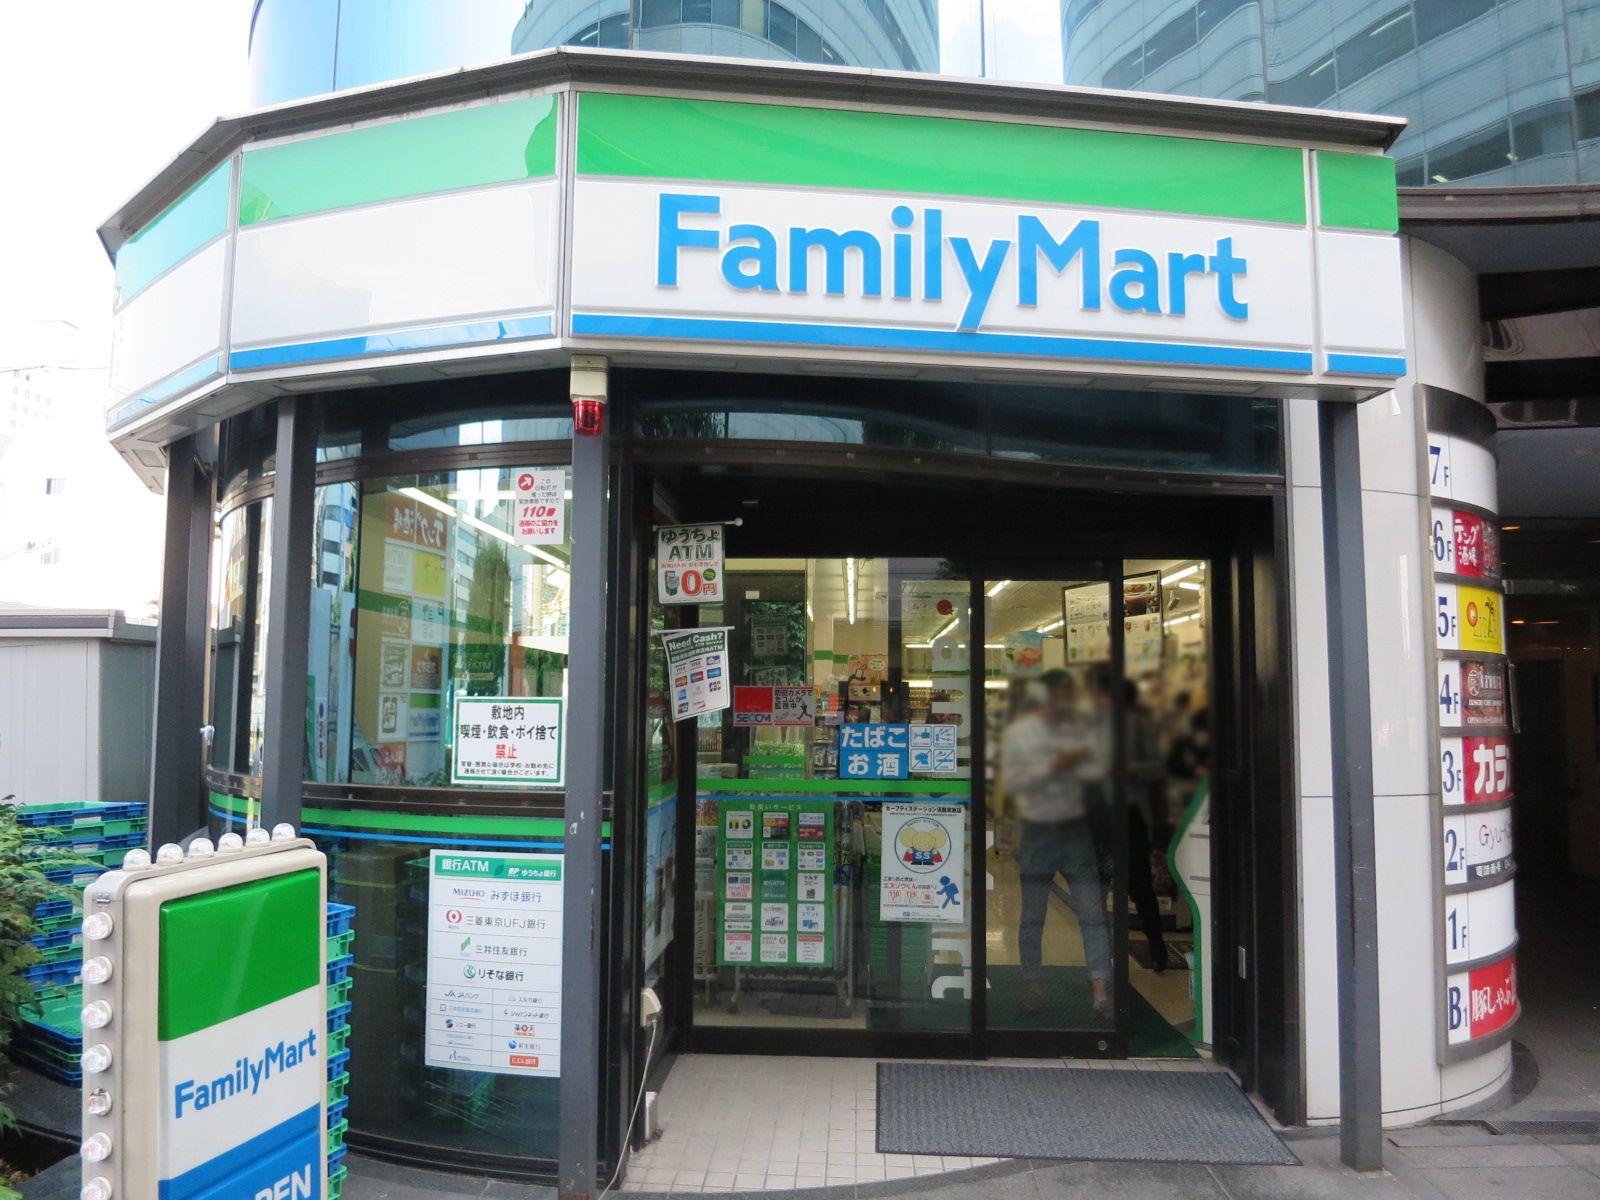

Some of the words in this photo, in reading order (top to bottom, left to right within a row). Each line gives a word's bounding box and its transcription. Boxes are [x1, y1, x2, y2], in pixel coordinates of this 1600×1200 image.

[655, 193, 1249, 332] FamilyMart
[1429, 446, 1449, 487] 7F
[661, 528, 719, 545] ゆうちょ
[1433, 520, 1453, 562] 6F
[669, 544, 713, 561] ATM
[1437, 596, 1457, 638] 5F
[668, 637, 692, 651] Need
[692, 632, 724, 644] Cash?
[775, 689, 813, 697] 防犯カメラで
[1440, 674, 1459, 715] 4F
[491, 704, 525, 720] 敷地内
[736, 713, 771, 722] SECOM
[460, 724, 557, 740] 喫煙・飲食・ポイ捨て
[841, 727, 907, 748] たばこ
[495, 744, 518, 759] 禁止
[847, 753, 900, 777] お酒
[1442, 750, 1462, 793] 3F
[1445, 829, 1465, 871] 2F
[441, 858, 490, 872] 銀行ATM
[521, 869, 557, 878] ゆうちょ銀行
[453, 887, 485, 897] MIZUHO
[490, 890, 542, 903] みずほ銀行
[466, 915, 546, 930] 三菱東京UFJ銀行
[1448, 908, 1467, 950] 1F
[476, 944, 527, 957] 三井住友銀行
[478, 969, 524, 982] りそな銀行
[1449, 986, 1468, 1030] B1
[175, 1028, 317, 1119] FamilyMart
